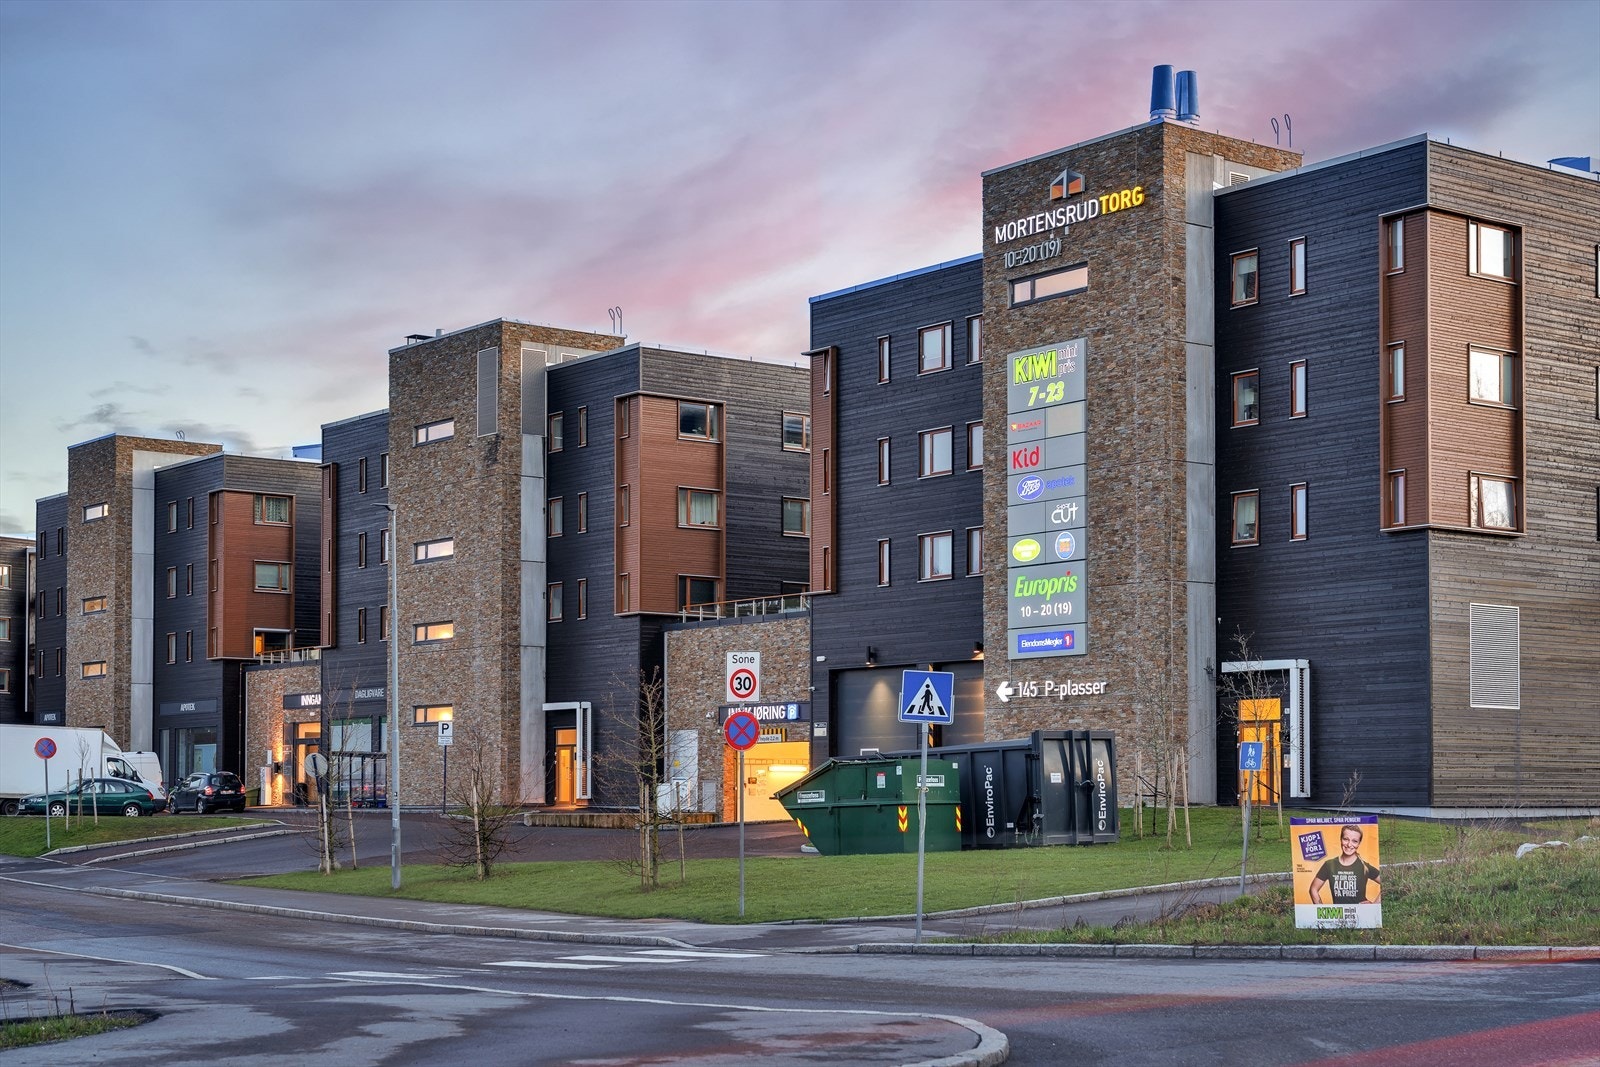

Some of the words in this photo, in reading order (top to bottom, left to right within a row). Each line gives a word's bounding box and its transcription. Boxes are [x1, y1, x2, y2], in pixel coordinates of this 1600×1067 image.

[1014, 350, 1057, 385] KIWI
[1012, 446, 1040, 470] Kid
[1014, 570, 1078, 601] Europris
[1020, 605, 1031, 617] 10
[1041, 604, 1052, 616] 20
[1054, 602, 1072, 616] (19)
[732, 654, 755, 664] Sone
[735, 676, 752, 691] 30
[1017, 680, 1037, 698] 145
[1045, 680, 1107, 700] P-plasser
[354, 688, 385, 699] DAGLIGVARE
[441, 723, 450, 734] P
[985, 766, 995, 827] EnviroPac
[1097, 759, 1107, 819] EnviroPac
[1300, 834, 1317, 843] KJØP
[1305, 845, 1318, 853] FOR
[1333, 880, 1357, 890] ALDRI
[1316, 906, 1344, 920] KIWI
